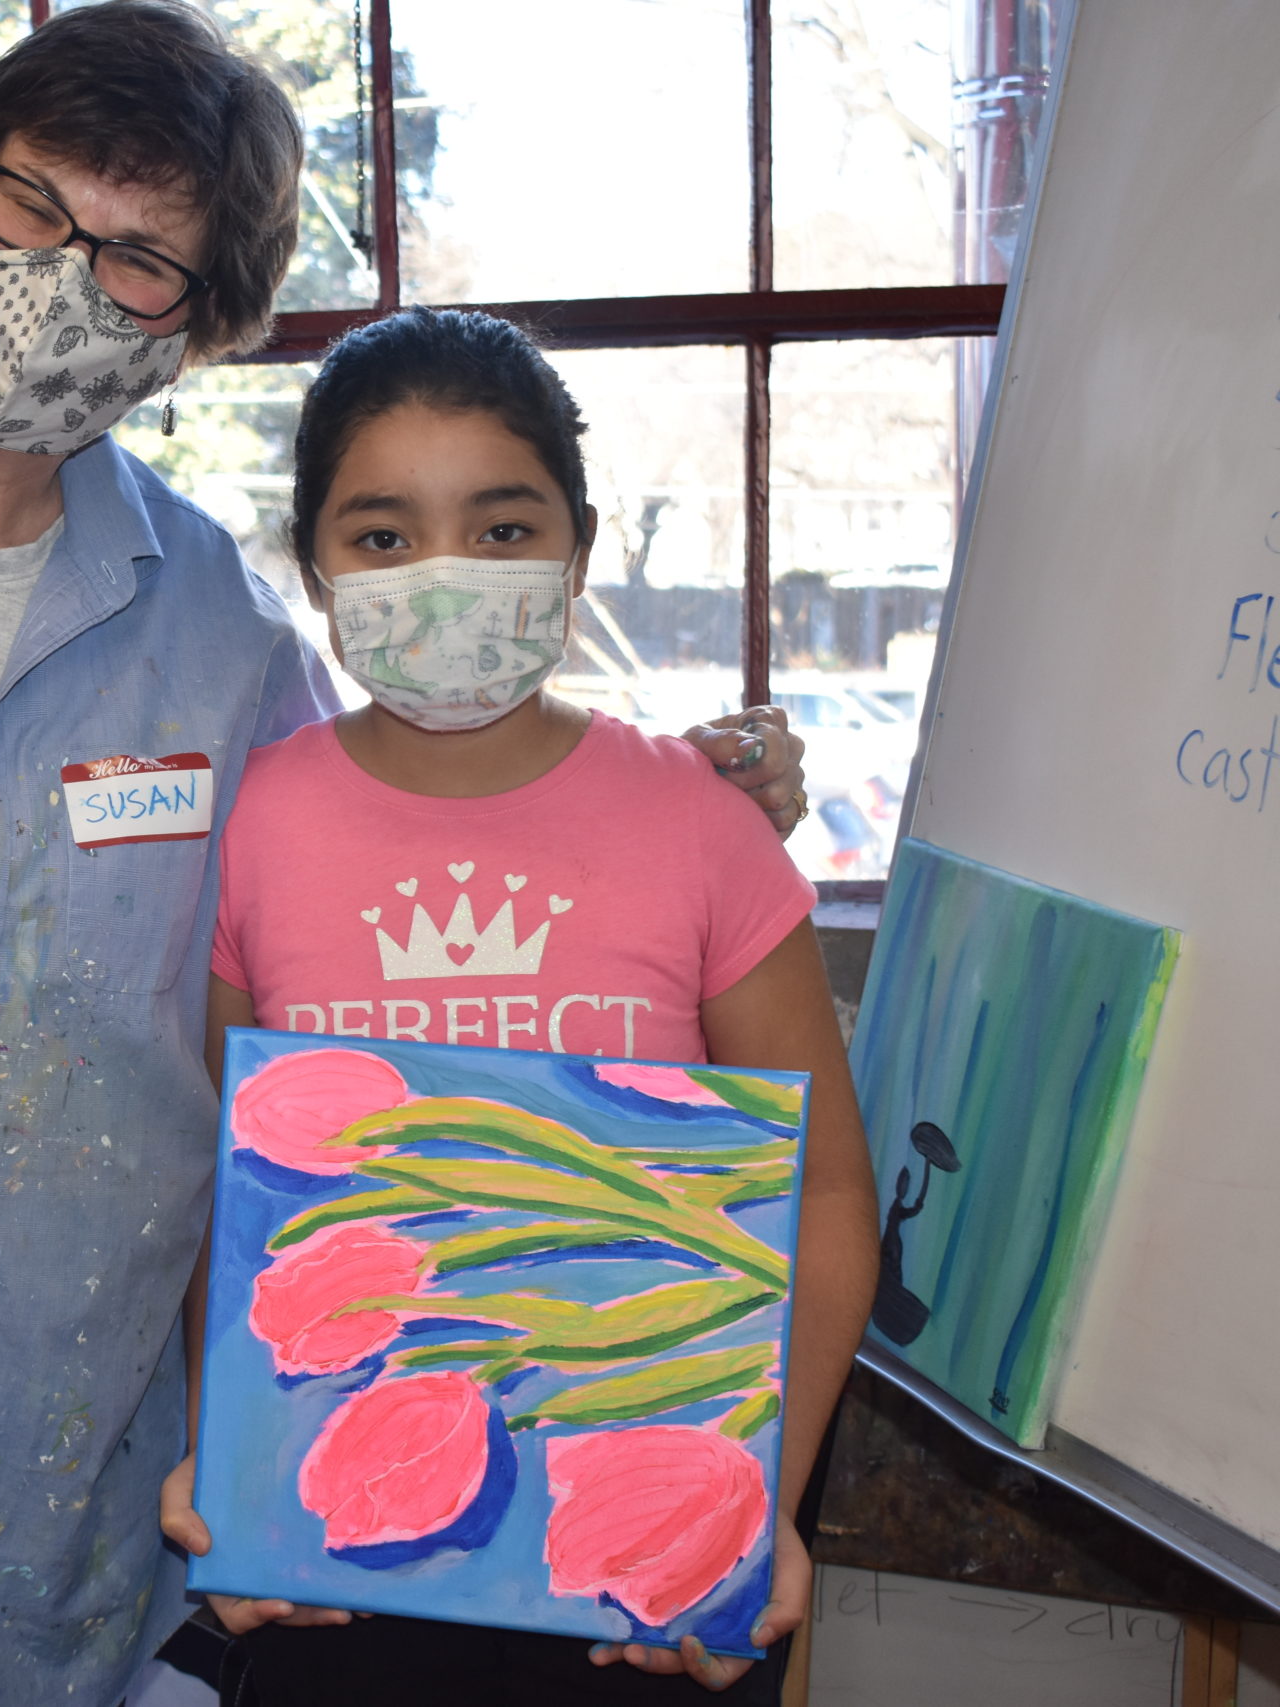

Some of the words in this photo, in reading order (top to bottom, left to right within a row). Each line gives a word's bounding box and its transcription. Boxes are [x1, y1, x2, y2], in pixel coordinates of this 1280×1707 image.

[89, 757, 141, 779] Hello
[86, 771, 196, 823] SUSAN
[285, 994, 653, 1058] PERFECT
